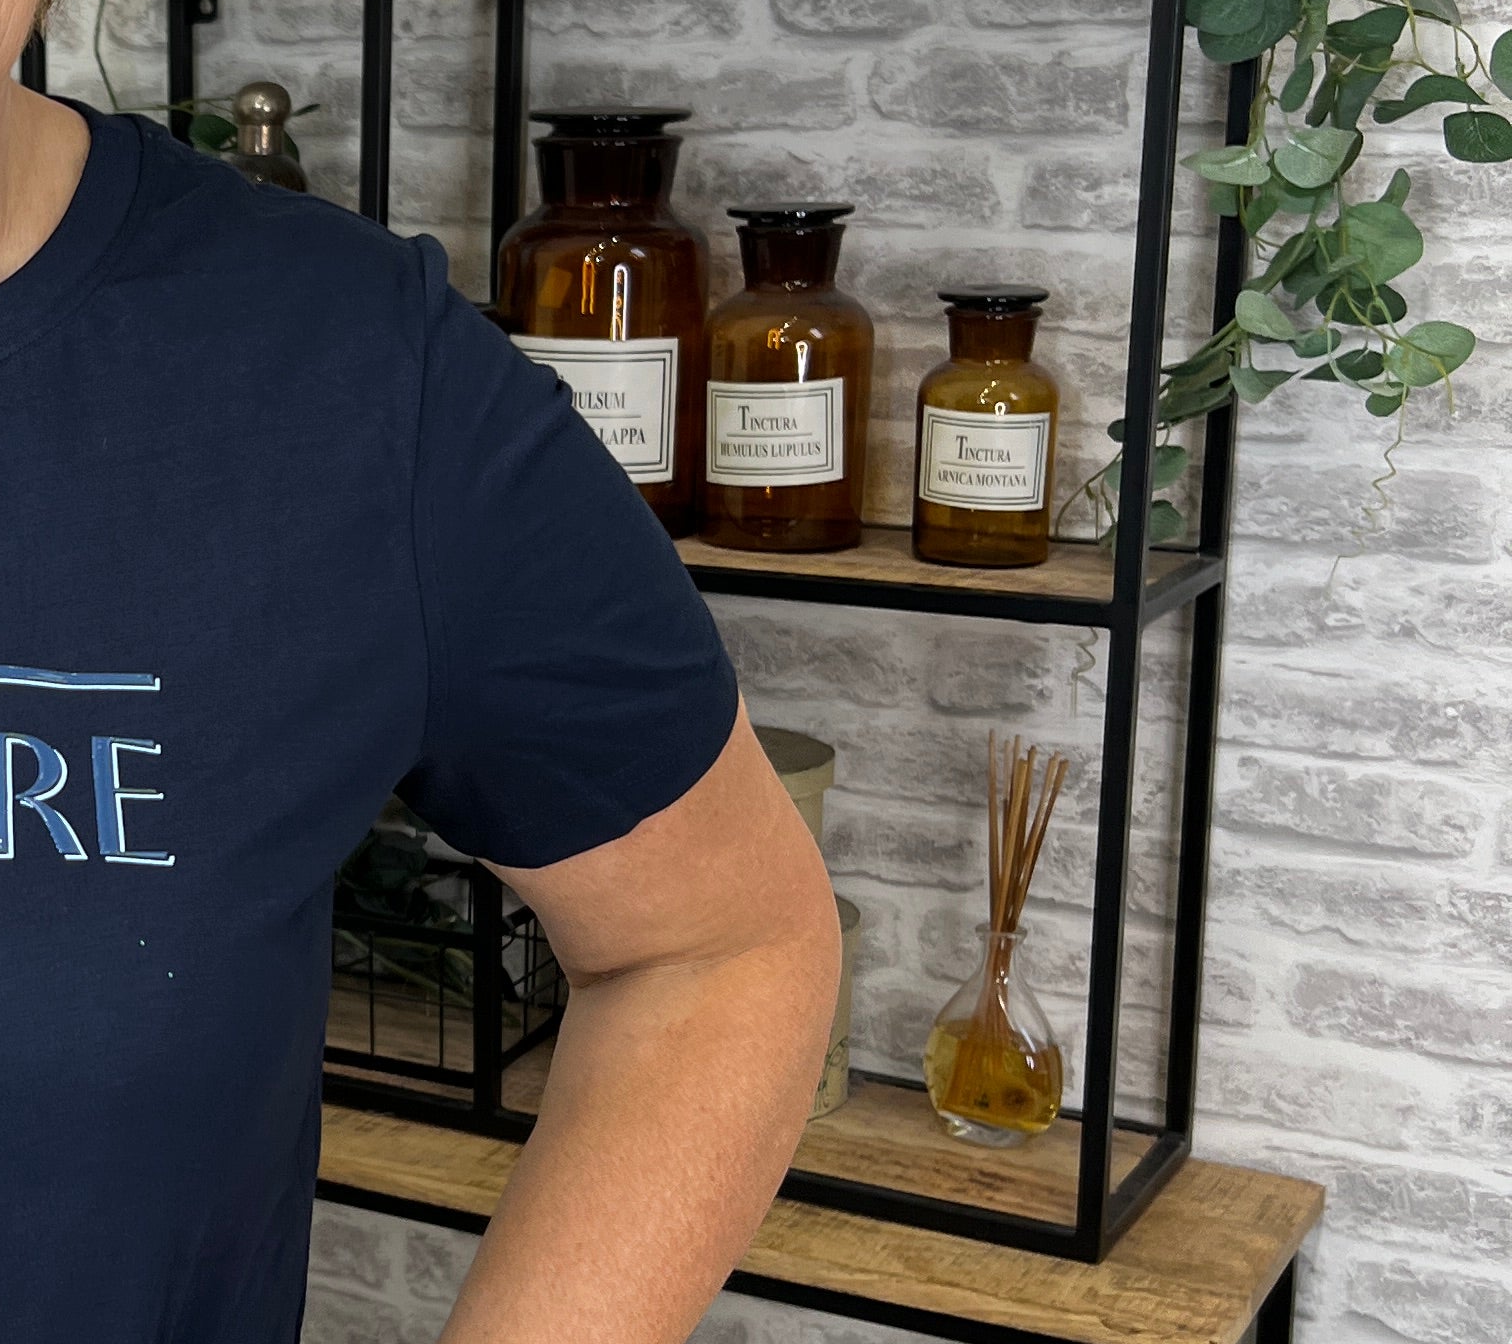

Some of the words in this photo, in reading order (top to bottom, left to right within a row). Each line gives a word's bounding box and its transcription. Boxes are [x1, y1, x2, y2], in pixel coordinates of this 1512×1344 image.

[573, 392, 626, 410] ULSUM
[771, 441, 821, 458] LUPULUS
[938, 469, 974, 486] ARNICA
[976, 472, 1027, 487] MONTANA
